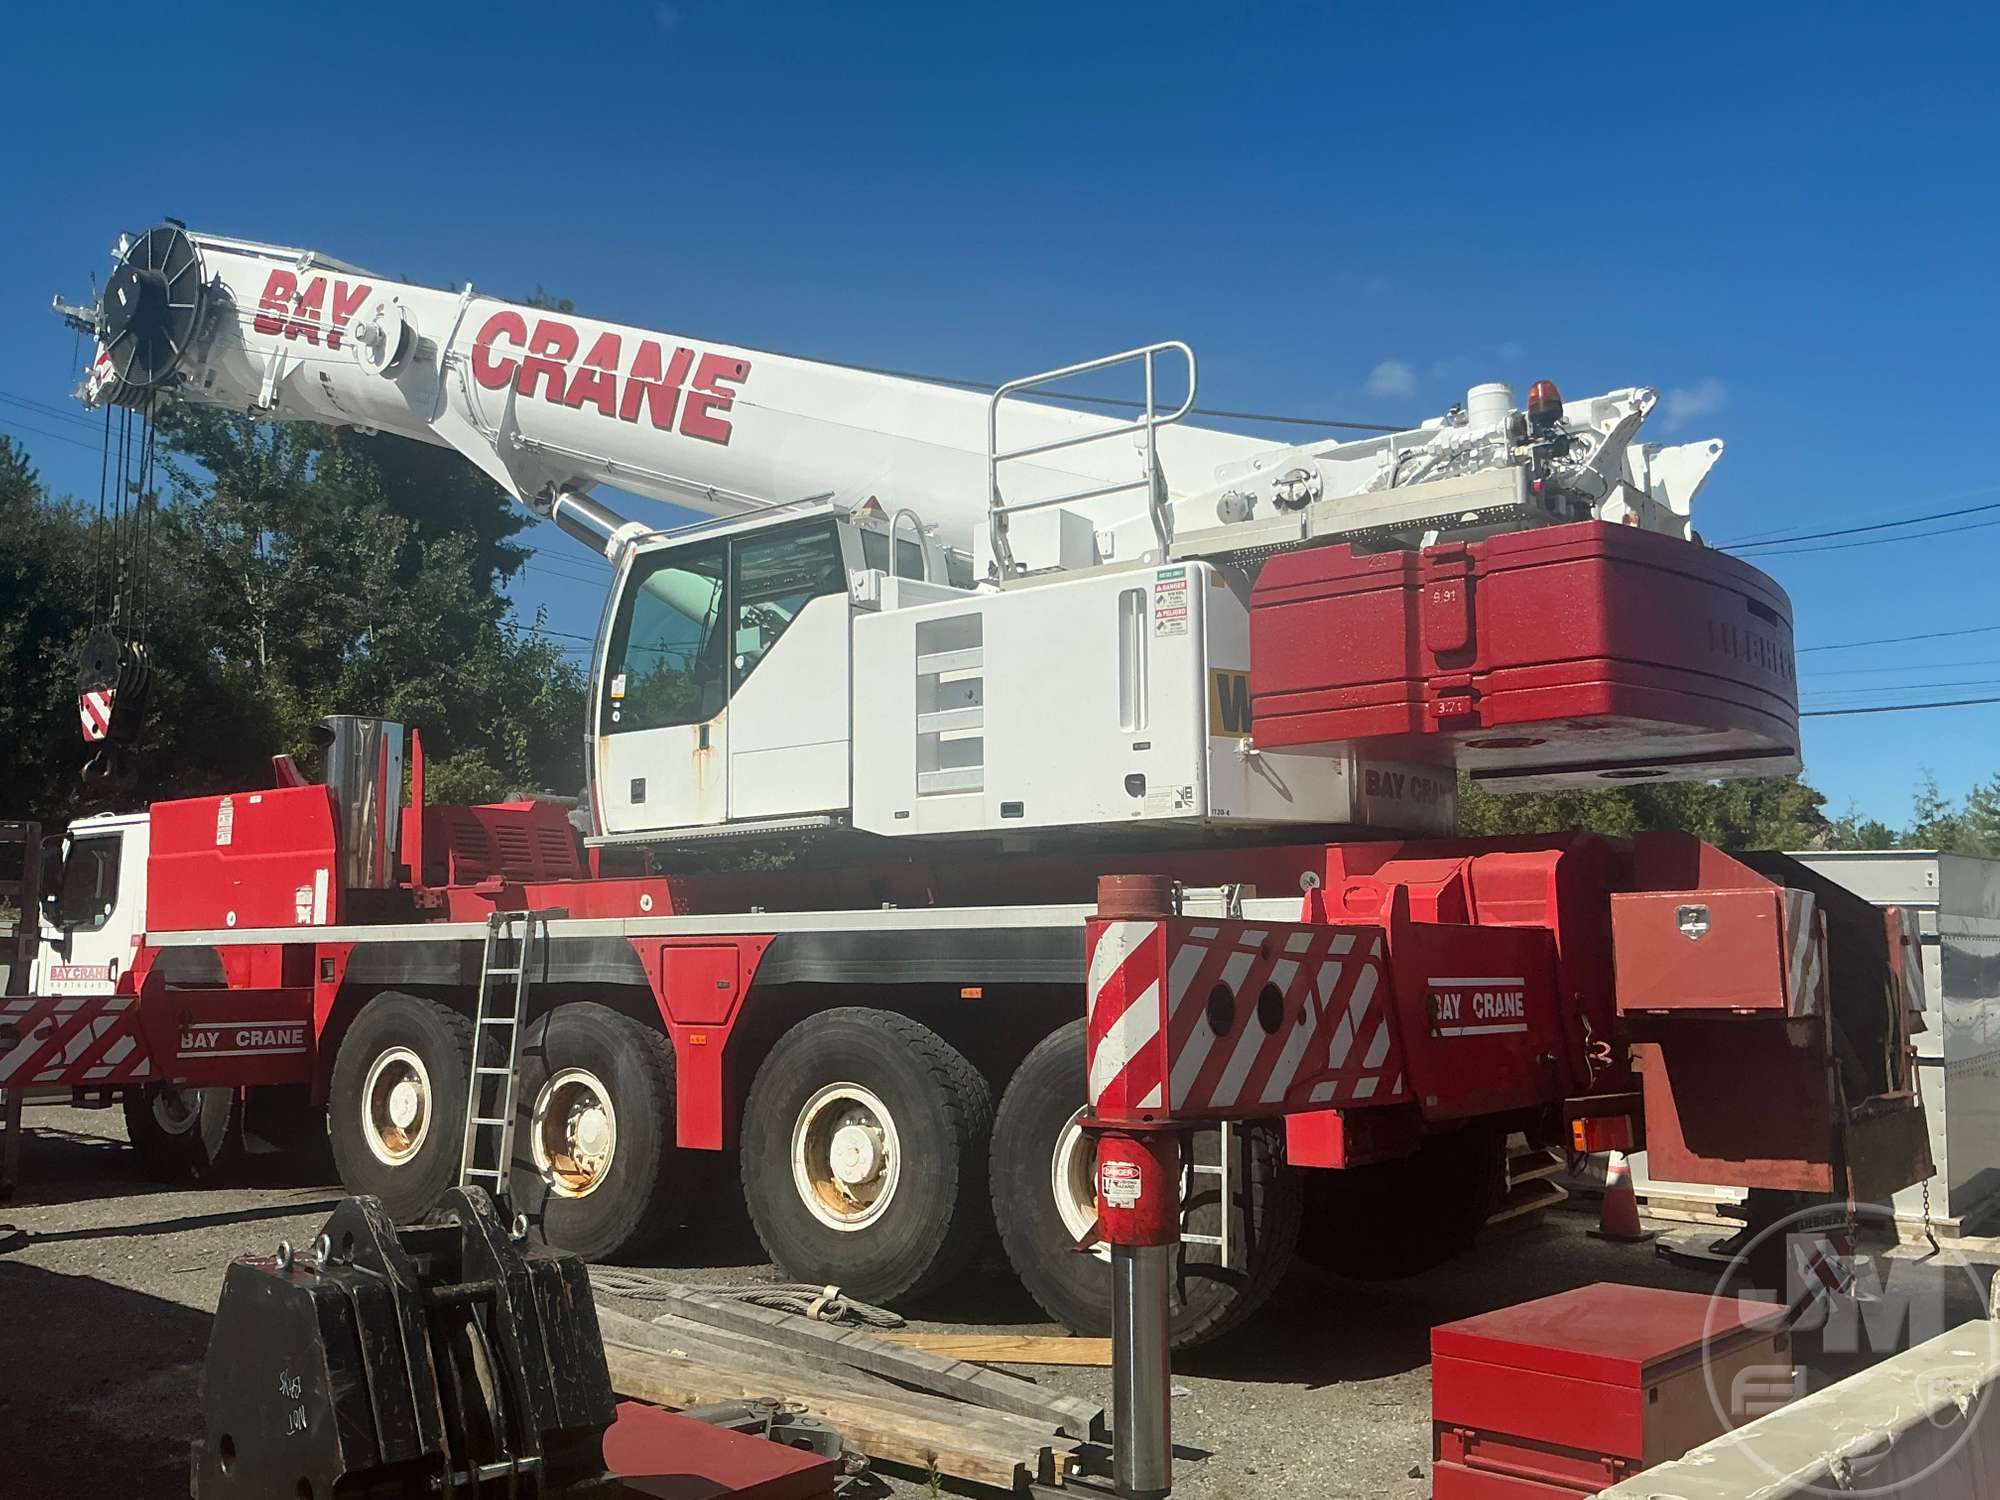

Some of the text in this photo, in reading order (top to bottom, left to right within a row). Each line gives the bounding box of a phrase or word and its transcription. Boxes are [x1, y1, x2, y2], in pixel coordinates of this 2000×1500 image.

[254, 269, 752, 446] BAY CRANE
[1365, 769, 1454, 806] BAY CRA
[51, 967, 110, 980] BAY CRANE
[1472, 992, 1525, 1019] CRANE
[181, 1029, 304, 1049] BAY CRANE
